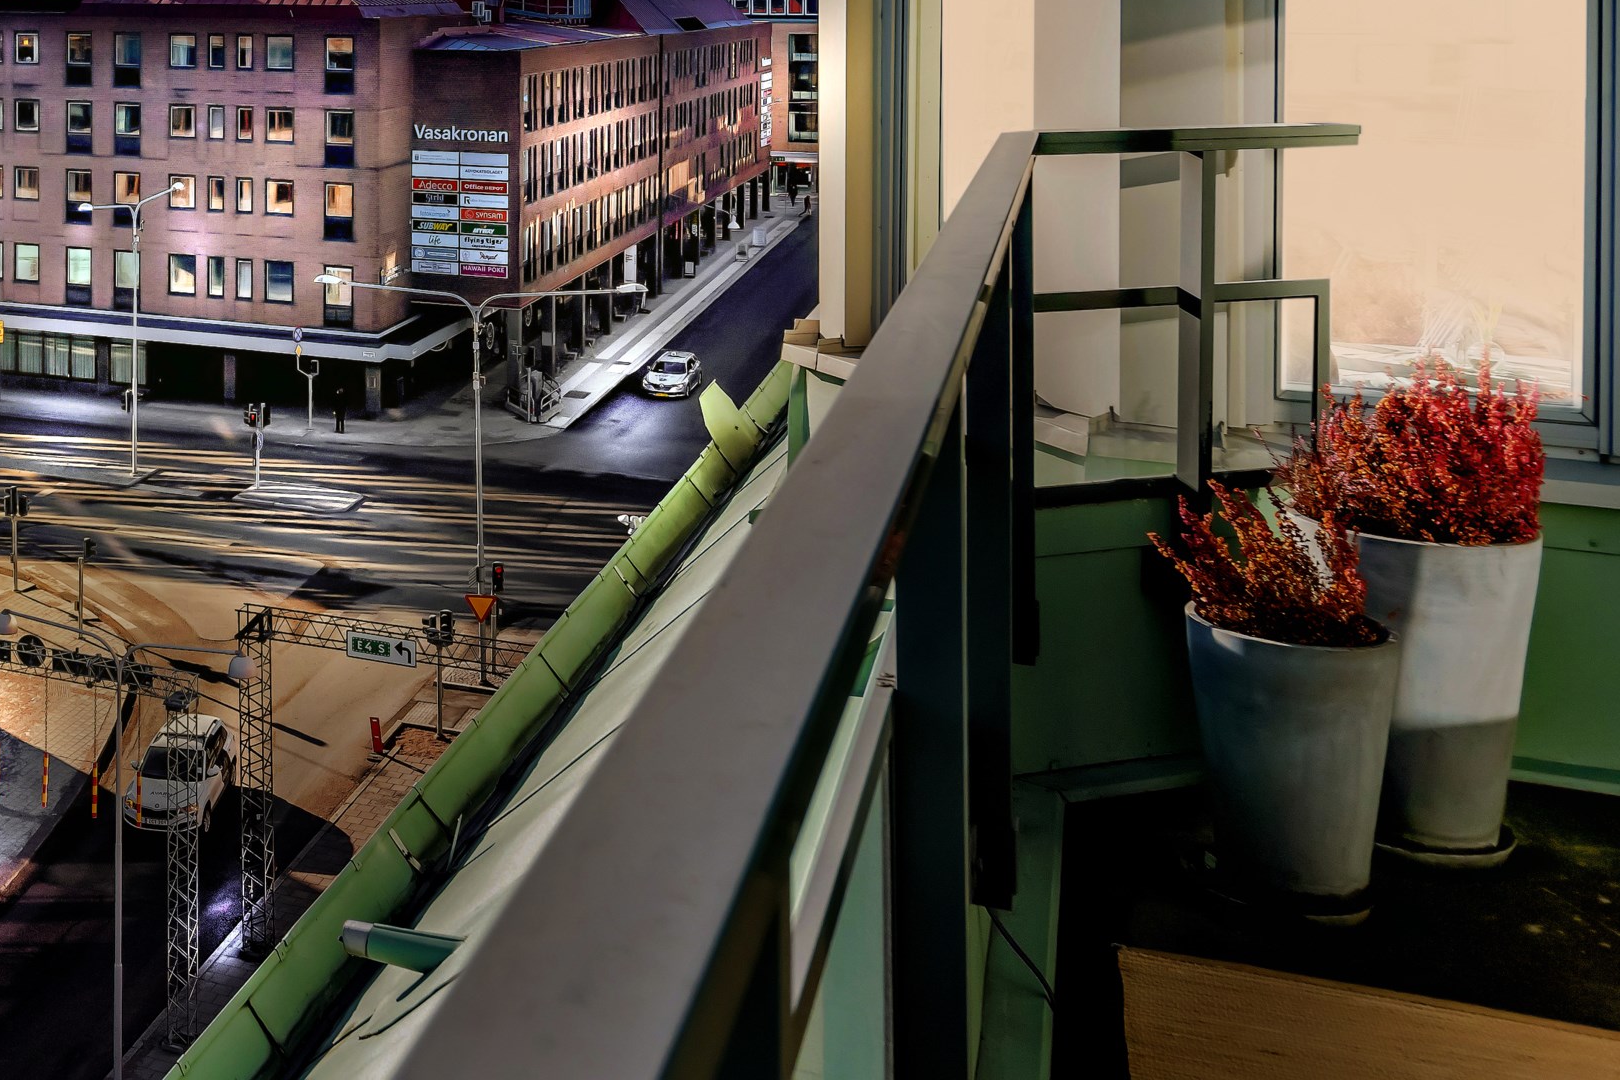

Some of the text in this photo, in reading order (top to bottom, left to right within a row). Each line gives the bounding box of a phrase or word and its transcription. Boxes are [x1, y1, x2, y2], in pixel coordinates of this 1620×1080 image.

[413, 124, 509, 143] Vasakronan
[418, 180, 453, 190] Adecco
[417, 221, 453, 231] SUBWAY
[464, 237, 485, 245] flying
[357, 640, 385, 653] E4 S
